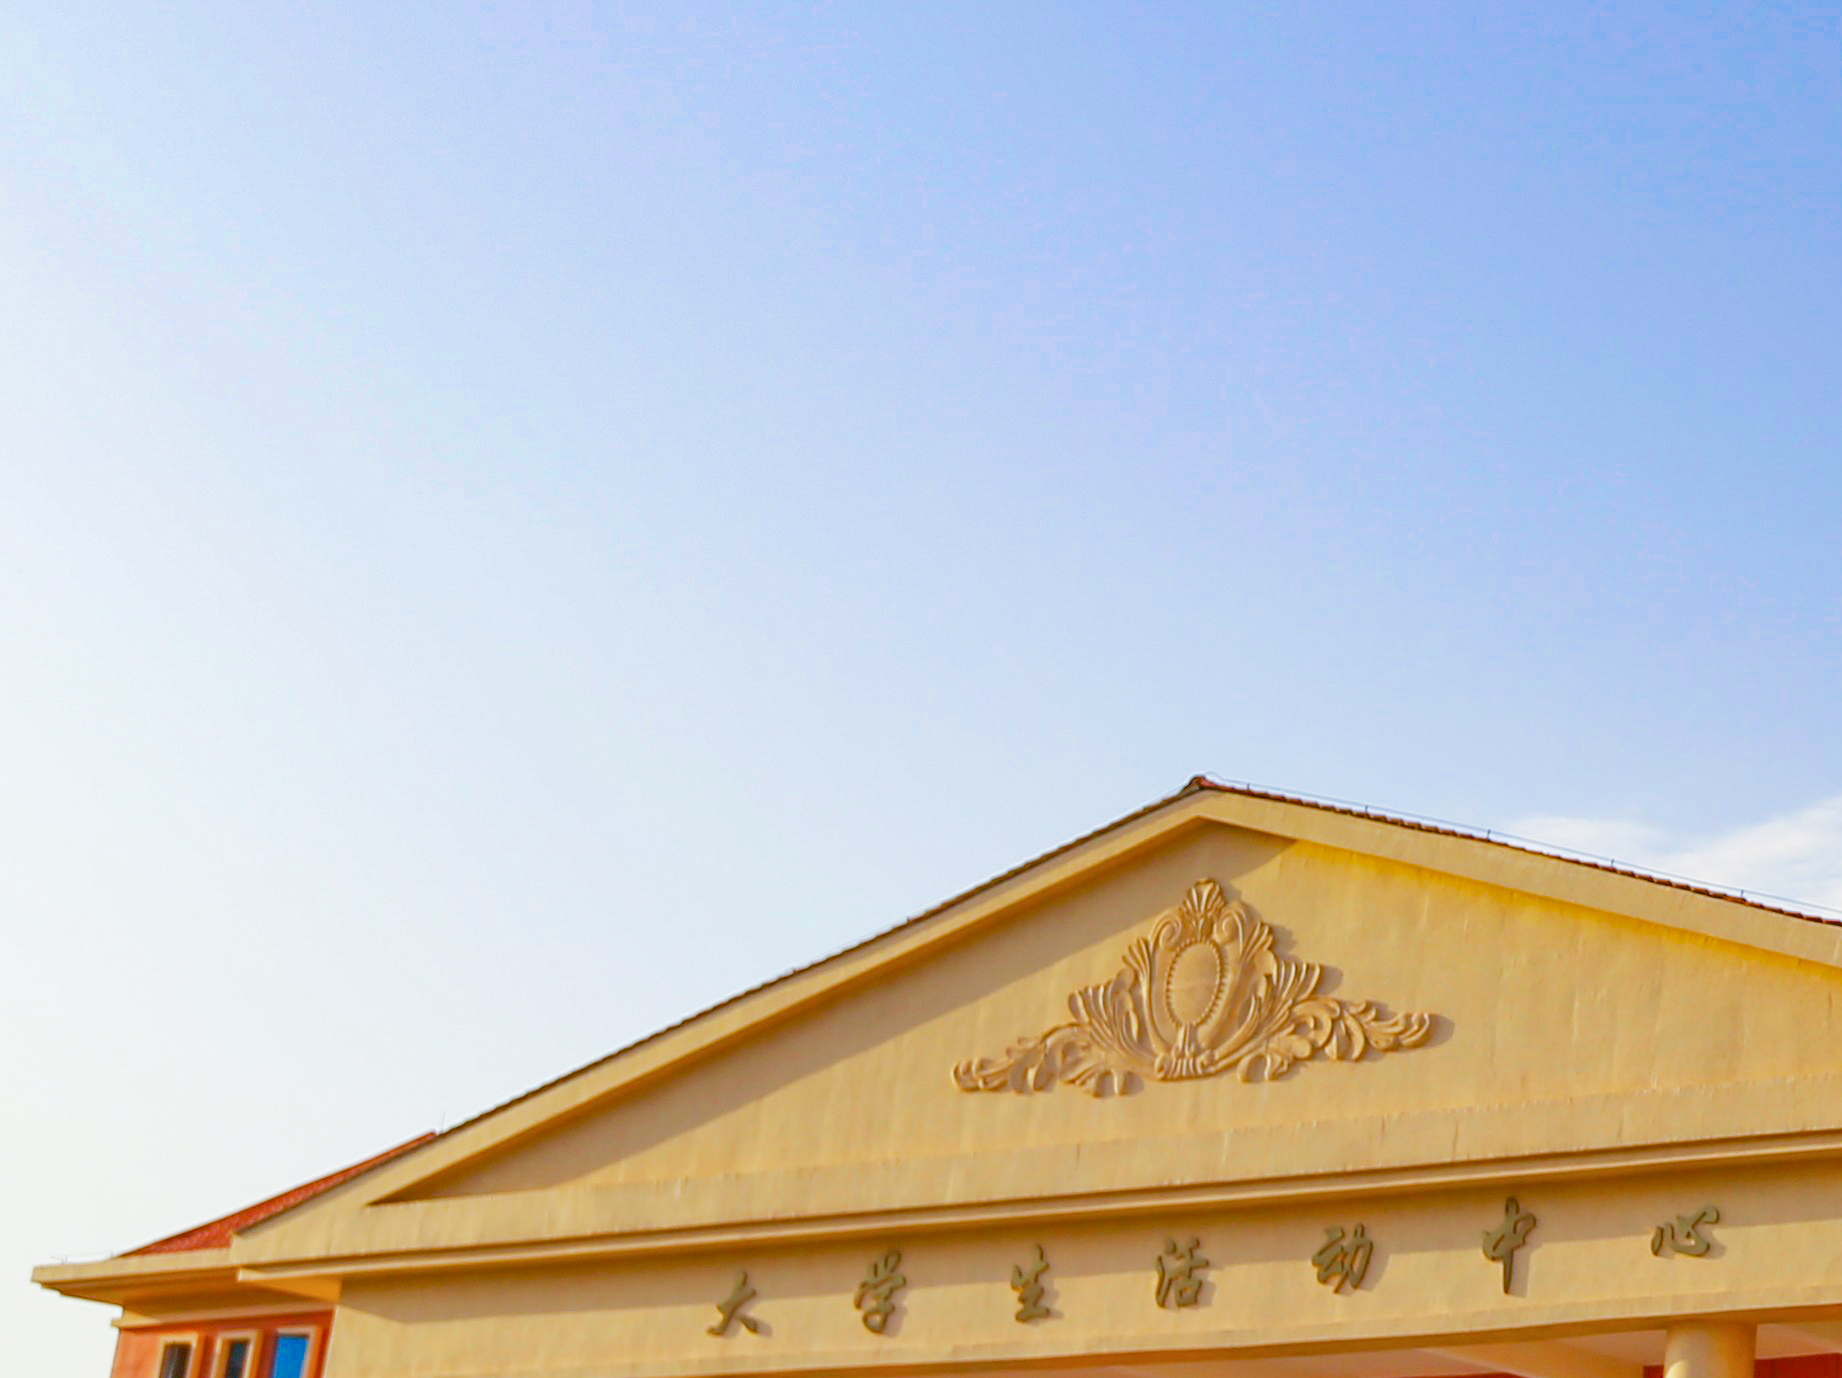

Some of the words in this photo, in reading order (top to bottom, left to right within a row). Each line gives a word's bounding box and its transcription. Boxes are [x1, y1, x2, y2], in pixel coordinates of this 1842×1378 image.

[706, 1196, 1720, 1336] 大学生活动中心
